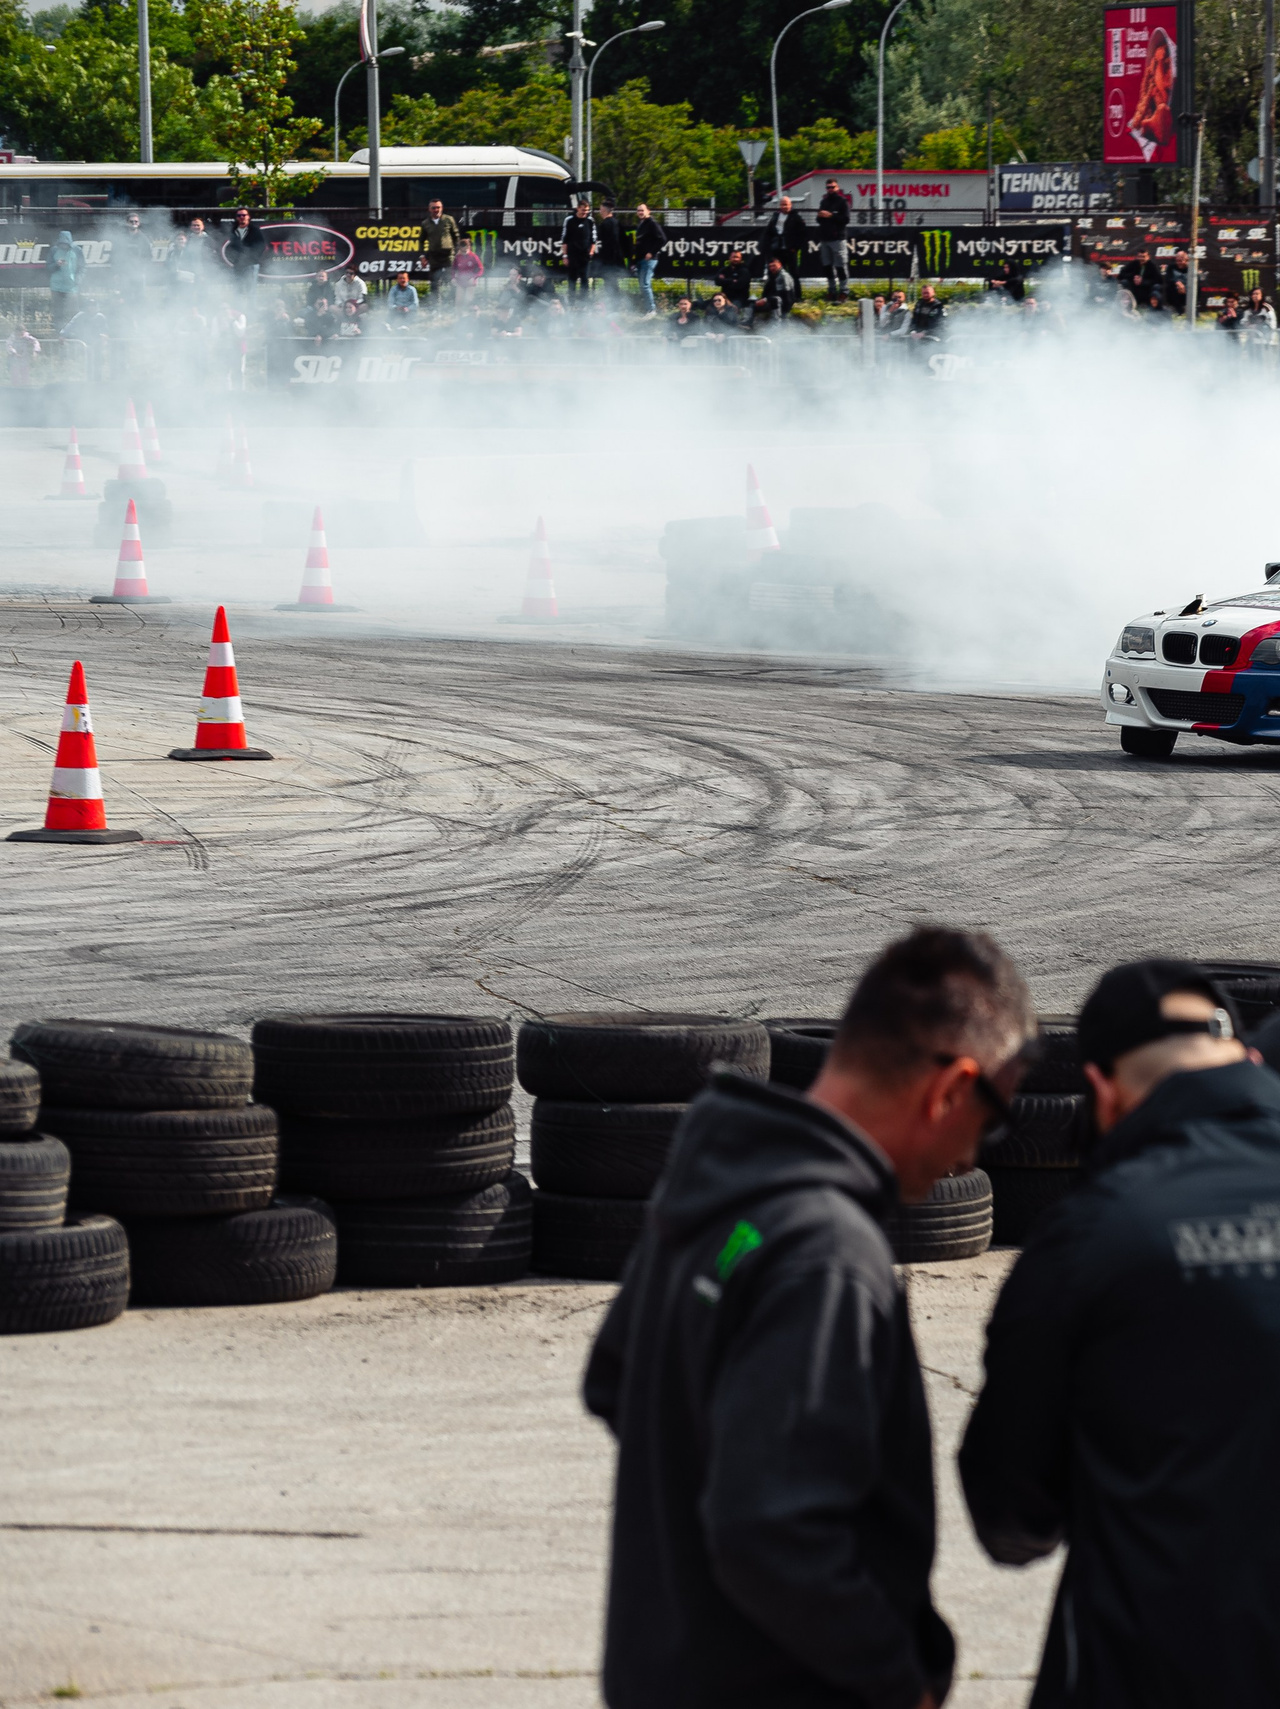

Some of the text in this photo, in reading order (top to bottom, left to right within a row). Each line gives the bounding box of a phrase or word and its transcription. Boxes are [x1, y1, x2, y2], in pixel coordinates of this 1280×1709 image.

[355, 226, 422, 239] GOSPOD
[808, 240, 912, 257] MNSTER
[957, 237, 1060, 257] MONSTER
[359, 262, 385, 274] 061
[388, 261, 413, 273] 321
